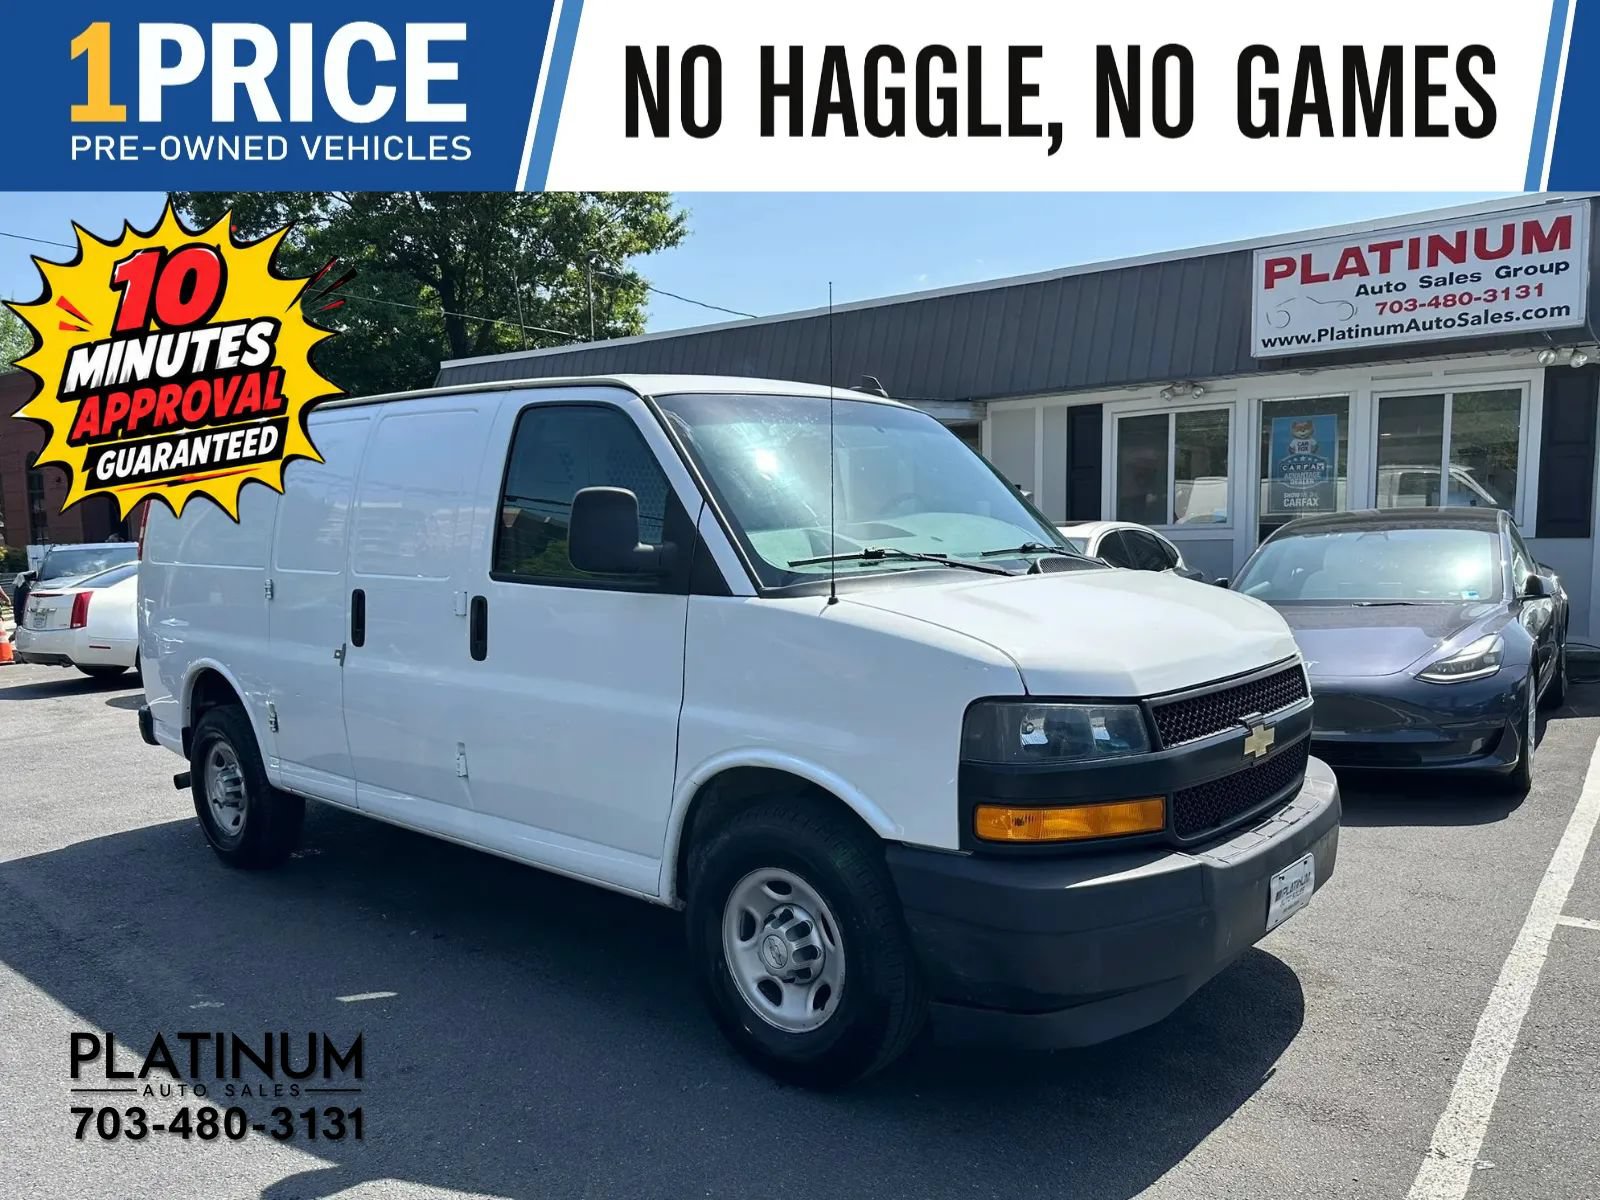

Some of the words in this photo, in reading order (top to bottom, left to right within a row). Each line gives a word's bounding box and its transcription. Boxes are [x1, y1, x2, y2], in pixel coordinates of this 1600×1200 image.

[1264, 215, 1572, 289] PLATINUM
[1355, 280, 1407, 297] Auto
[1418, 271, 1482, 289] Sales
[1494, 260, 1570, 279] Group
[1375, 282, 1544, 316] 703-480-3131
[1261, 304, 1571, 348] www.PlatinumAutoSales.com
[1282, 463, 1325, 471] CARFAX
[1283, 498, 1319, 507] CARFAX
